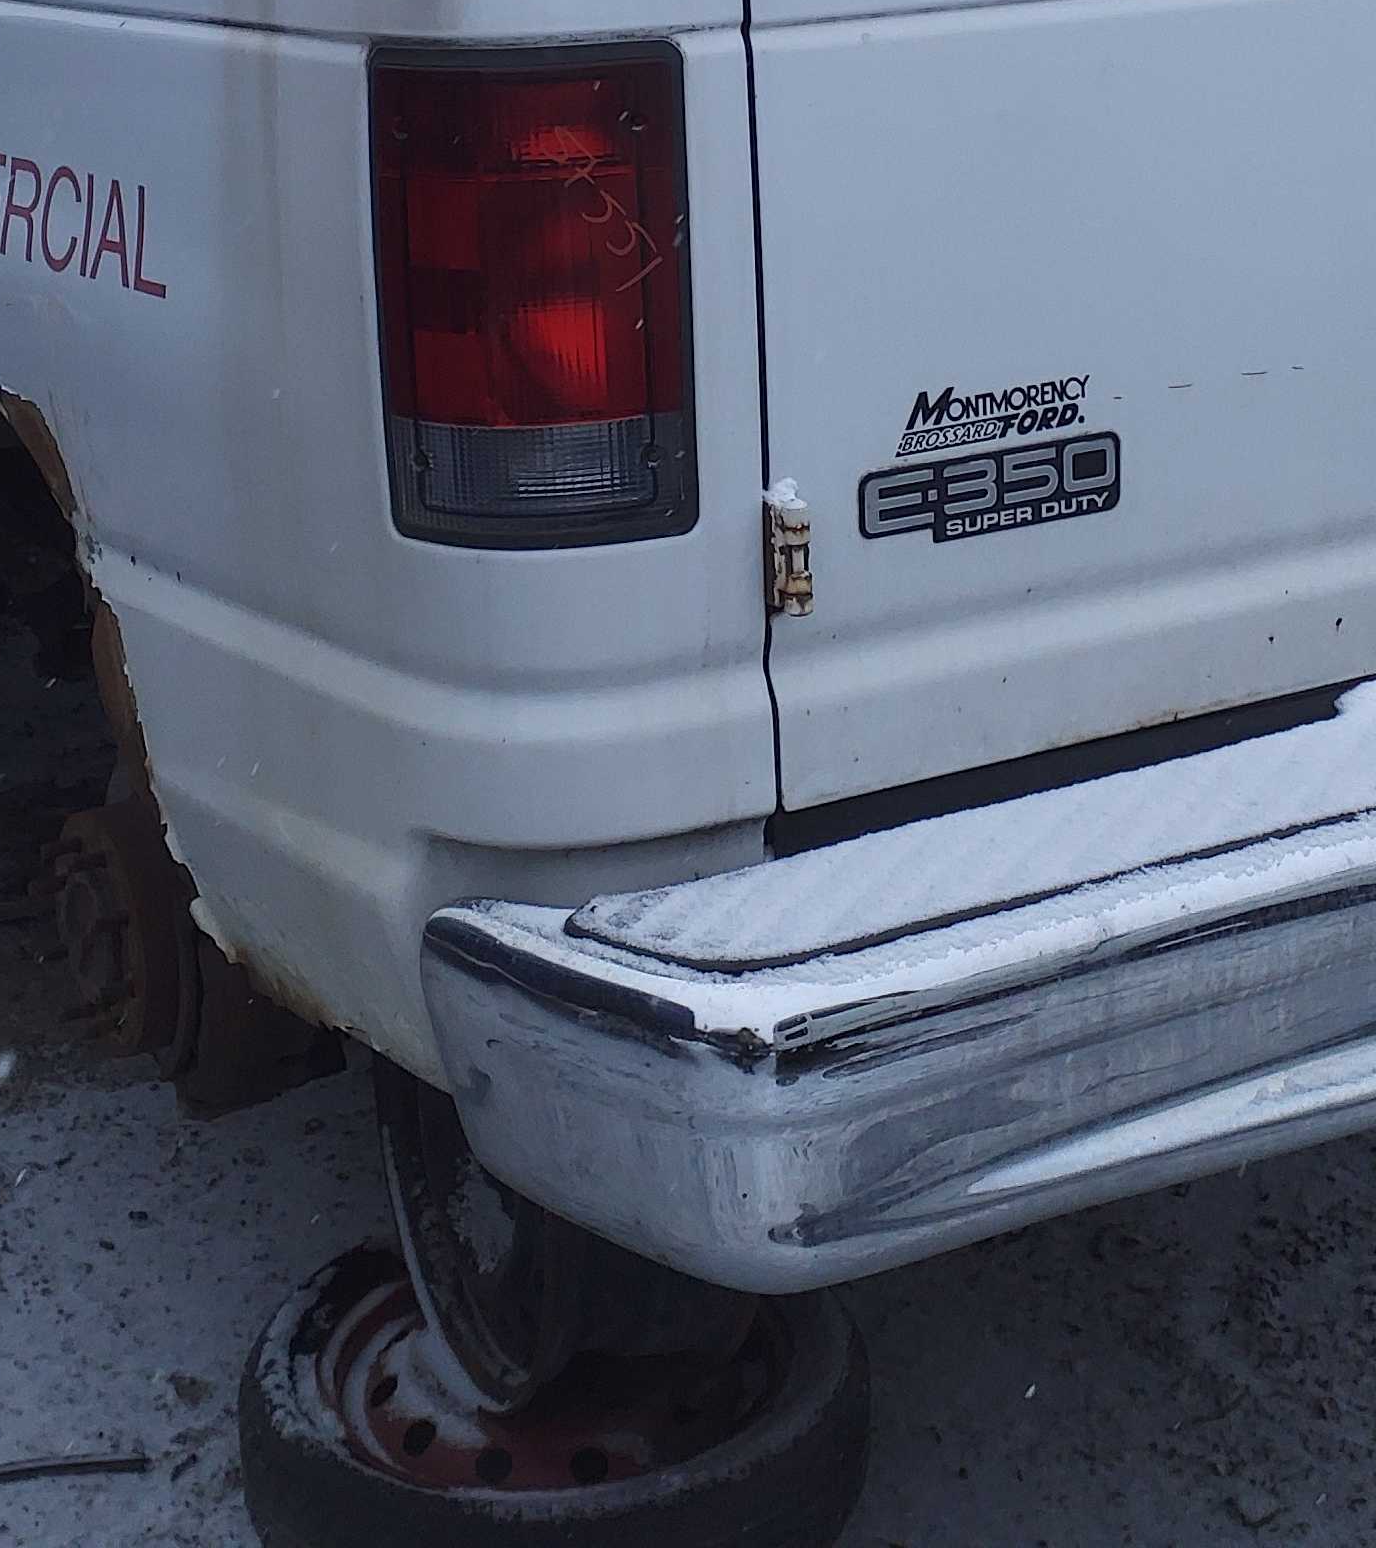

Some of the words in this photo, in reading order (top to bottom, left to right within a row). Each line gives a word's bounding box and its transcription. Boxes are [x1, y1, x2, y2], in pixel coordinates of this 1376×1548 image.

[899, 418, 1001, 454] BROSSARD
[945, 505, 1034, 538] SUPER
[1040, 490, 1110, 520] DUTY
